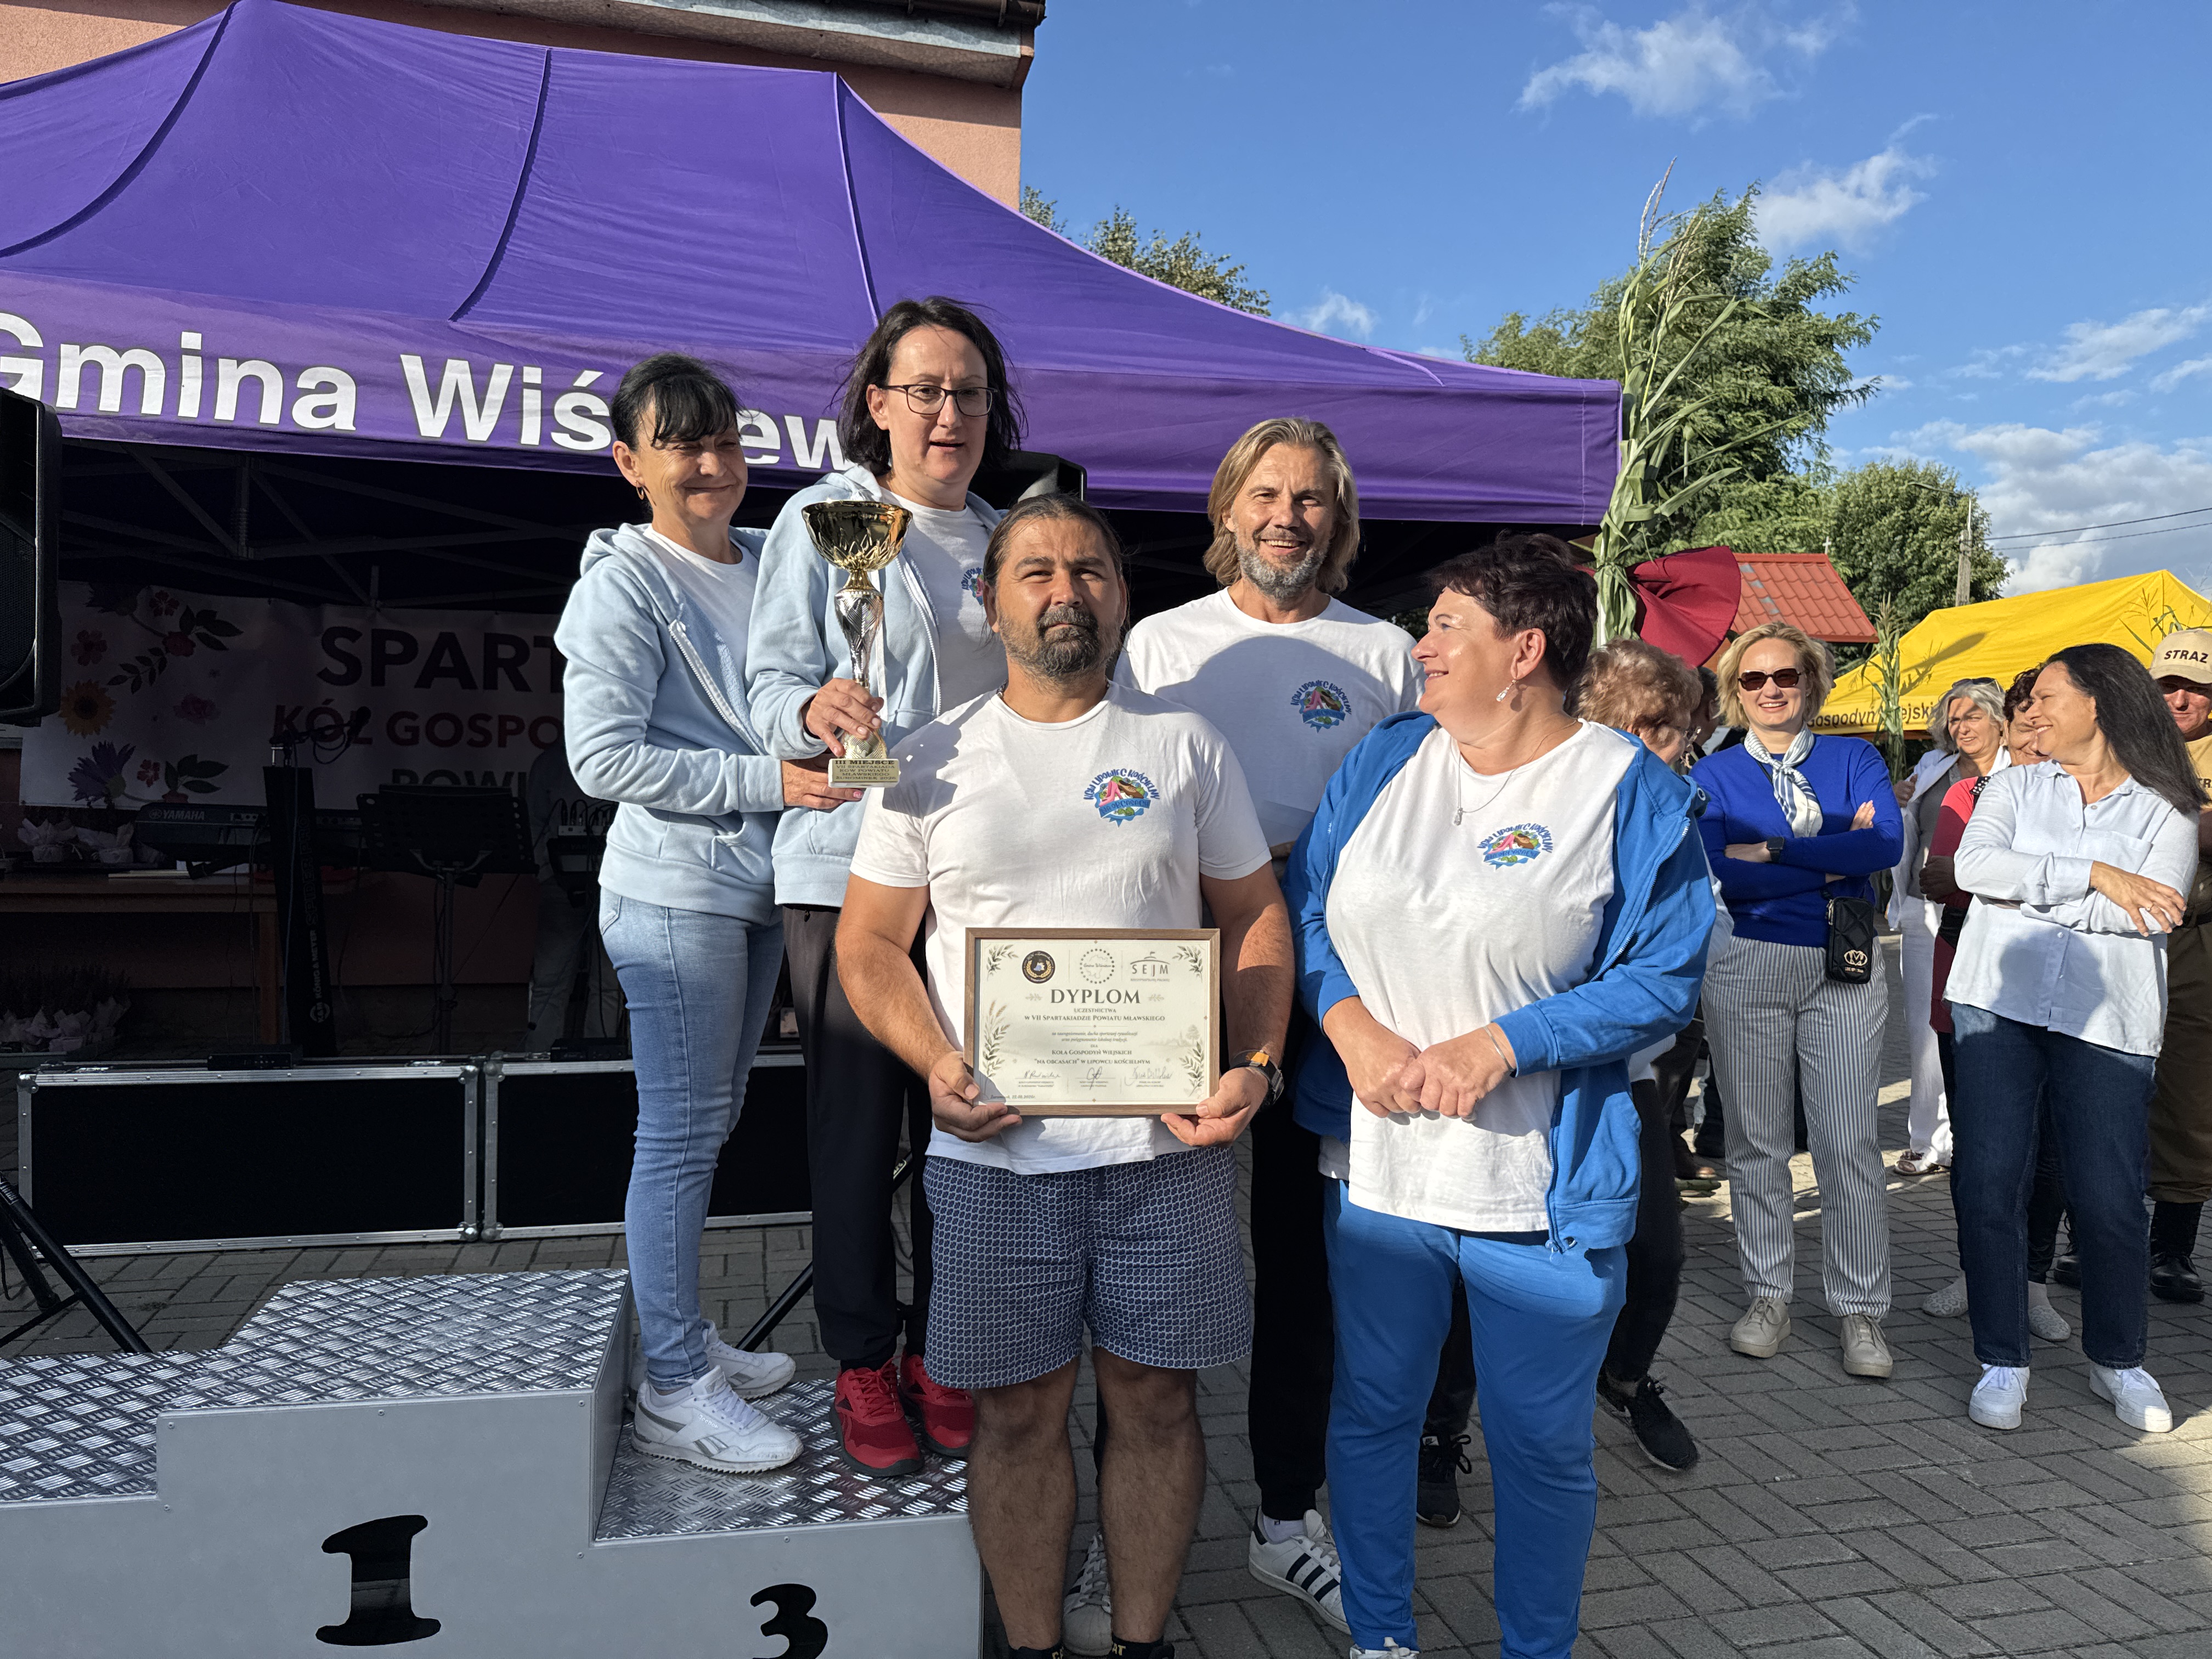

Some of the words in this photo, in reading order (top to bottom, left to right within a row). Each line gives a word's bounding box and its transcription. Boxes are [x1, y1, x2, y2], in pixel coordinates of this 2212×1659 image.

[0, 312, 356, 431] Gmina
[400, 354, 850, 471] Wiśew
[1084, 784, 1096, 799] KGW
[1092, 768, 1127, 785] LIPOWIEC
[1127, 769, 1160, 799] KOŚCIELNY
[163, 810, 205, 820] YAMAHA
[1132, 964, 1169, 977] SEJM
[1051, 989, 1141, 1003] DYPLOM
[697, 1414, 720, 1429] Reebok
[315, 1514, 442, 1646] 1
[749, 1583, 829, 1659] 3
